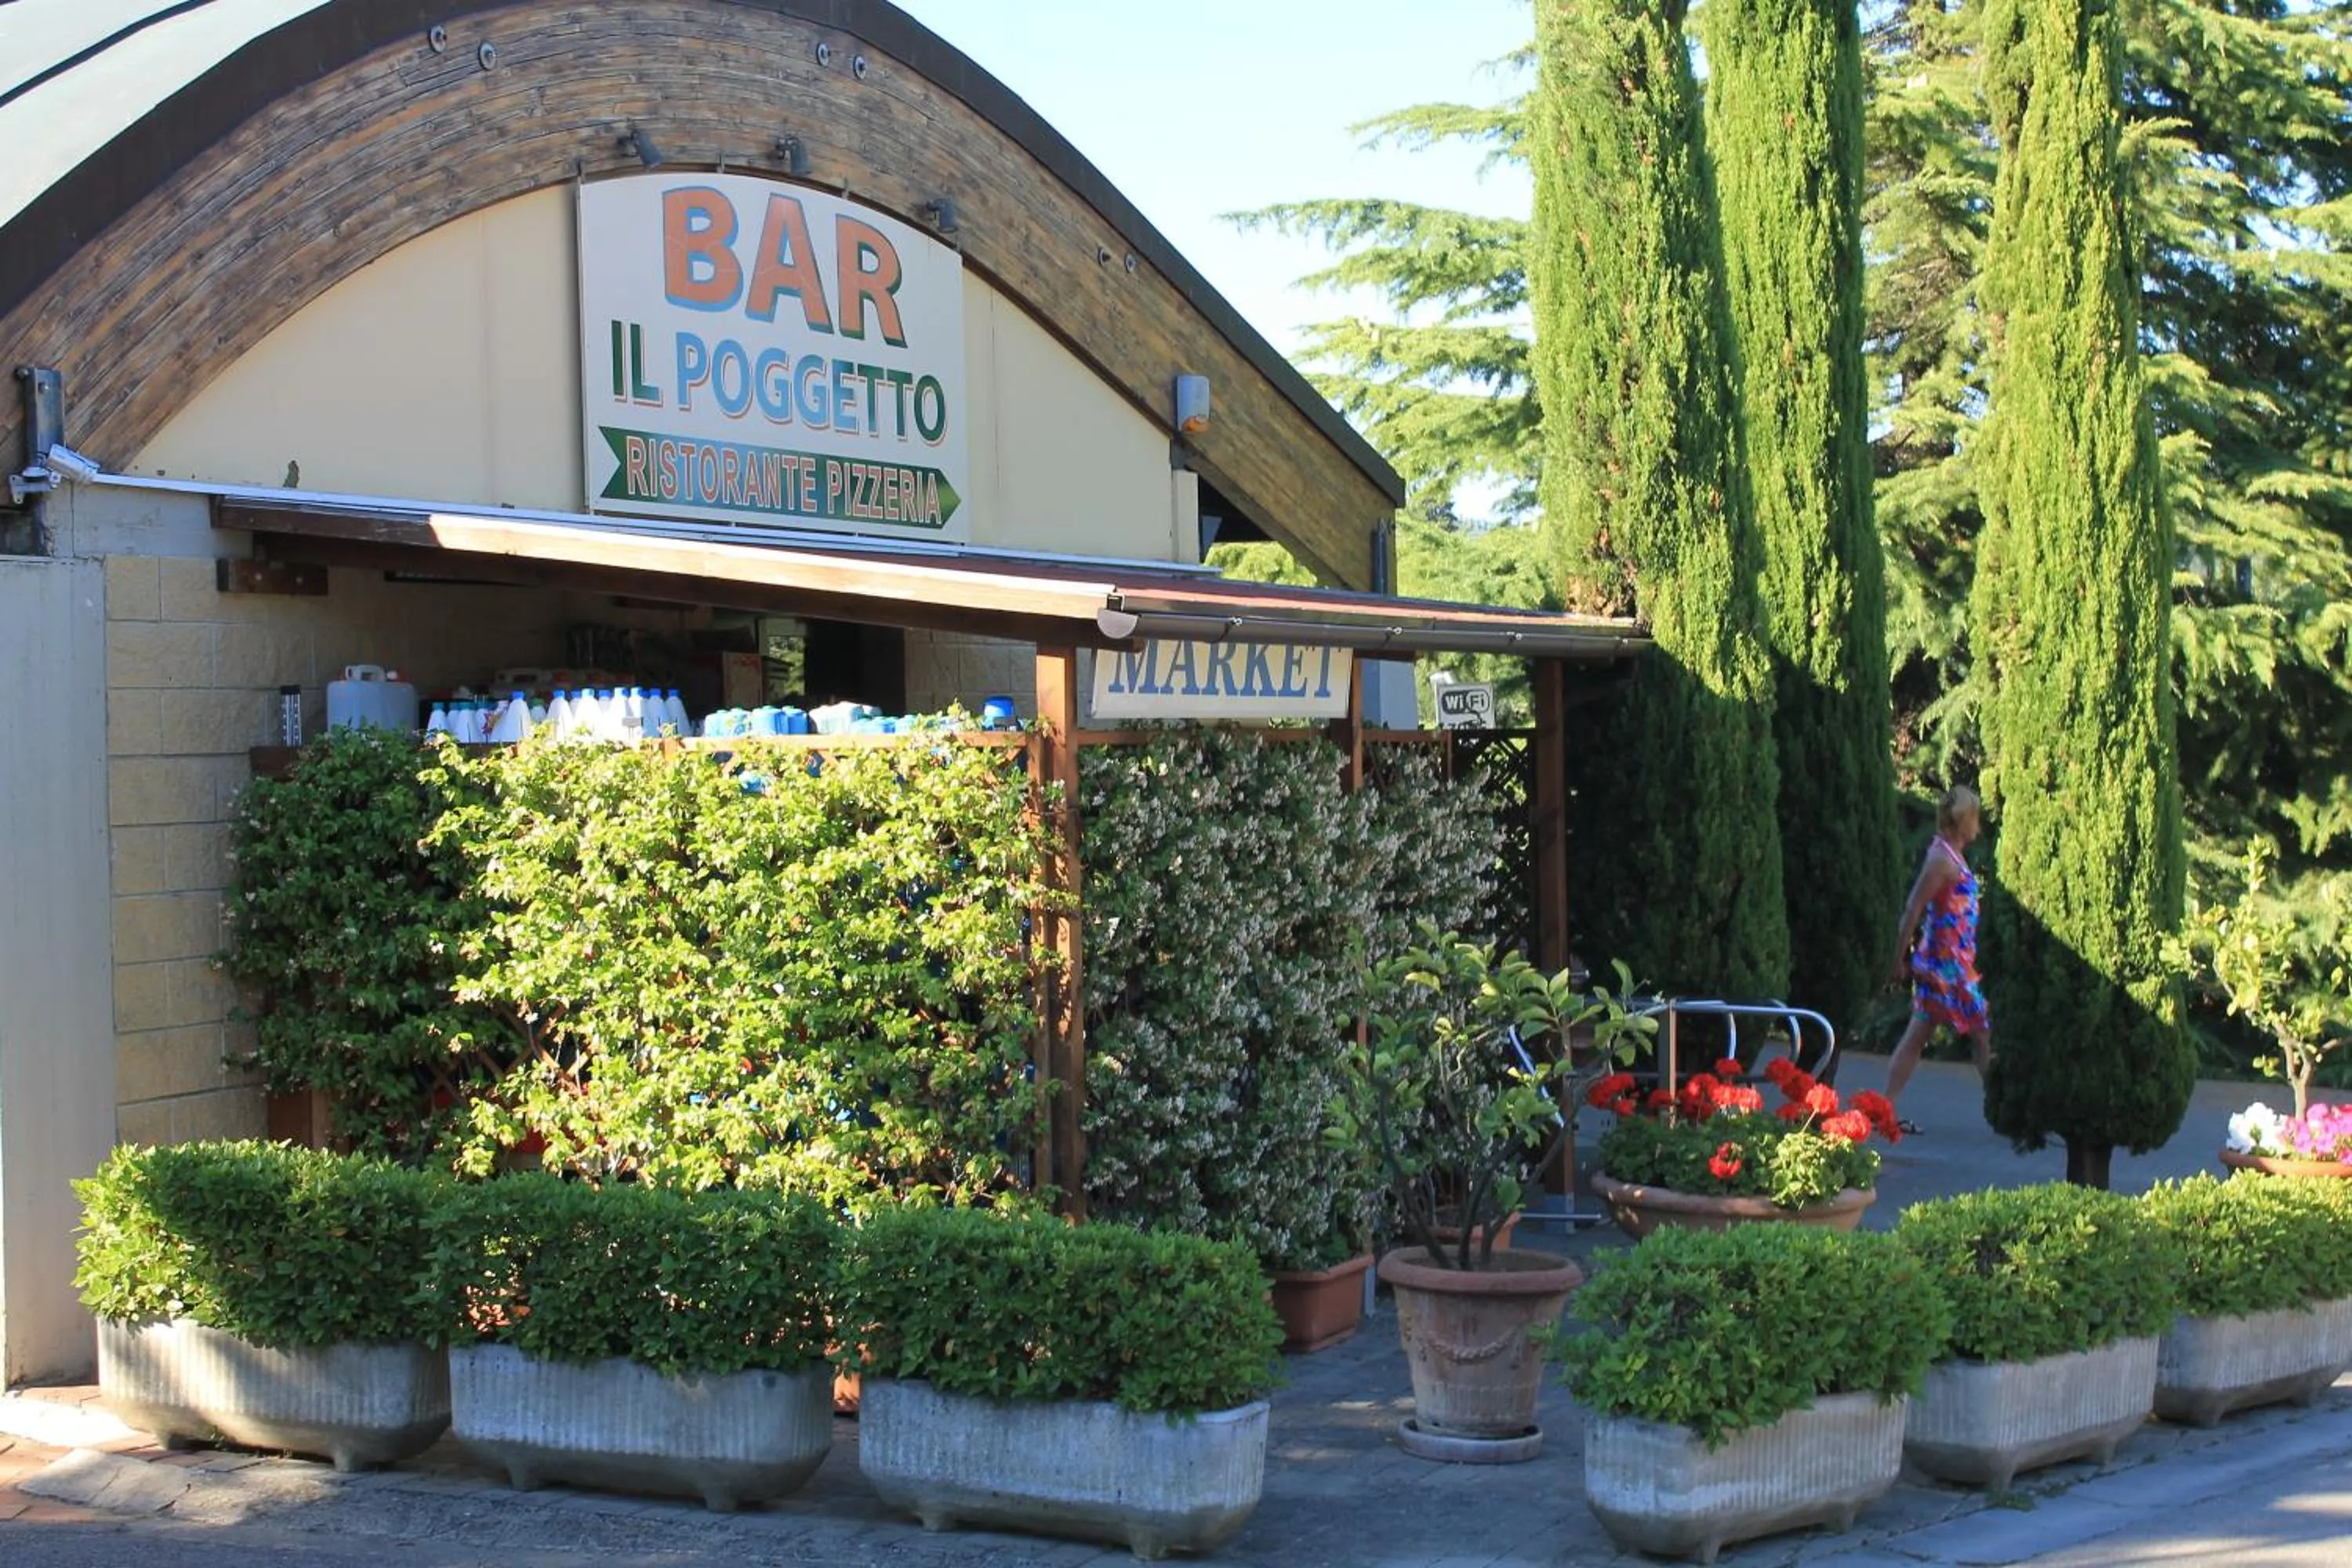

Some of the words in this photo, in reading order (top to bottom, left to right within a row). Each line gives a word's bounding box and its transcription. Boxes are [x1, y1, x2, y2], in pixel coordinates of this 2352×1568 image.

[662, 186, 907, 348] BAR
[611, 320, 663, 407] IL
[676, 332, 947, 447] POGGETTO
[626, 436, 818, 512] RISTORANTE
[826, 460, 942, 524] PIZZERIA
[1108, 639, 1342, 698] MARKET
